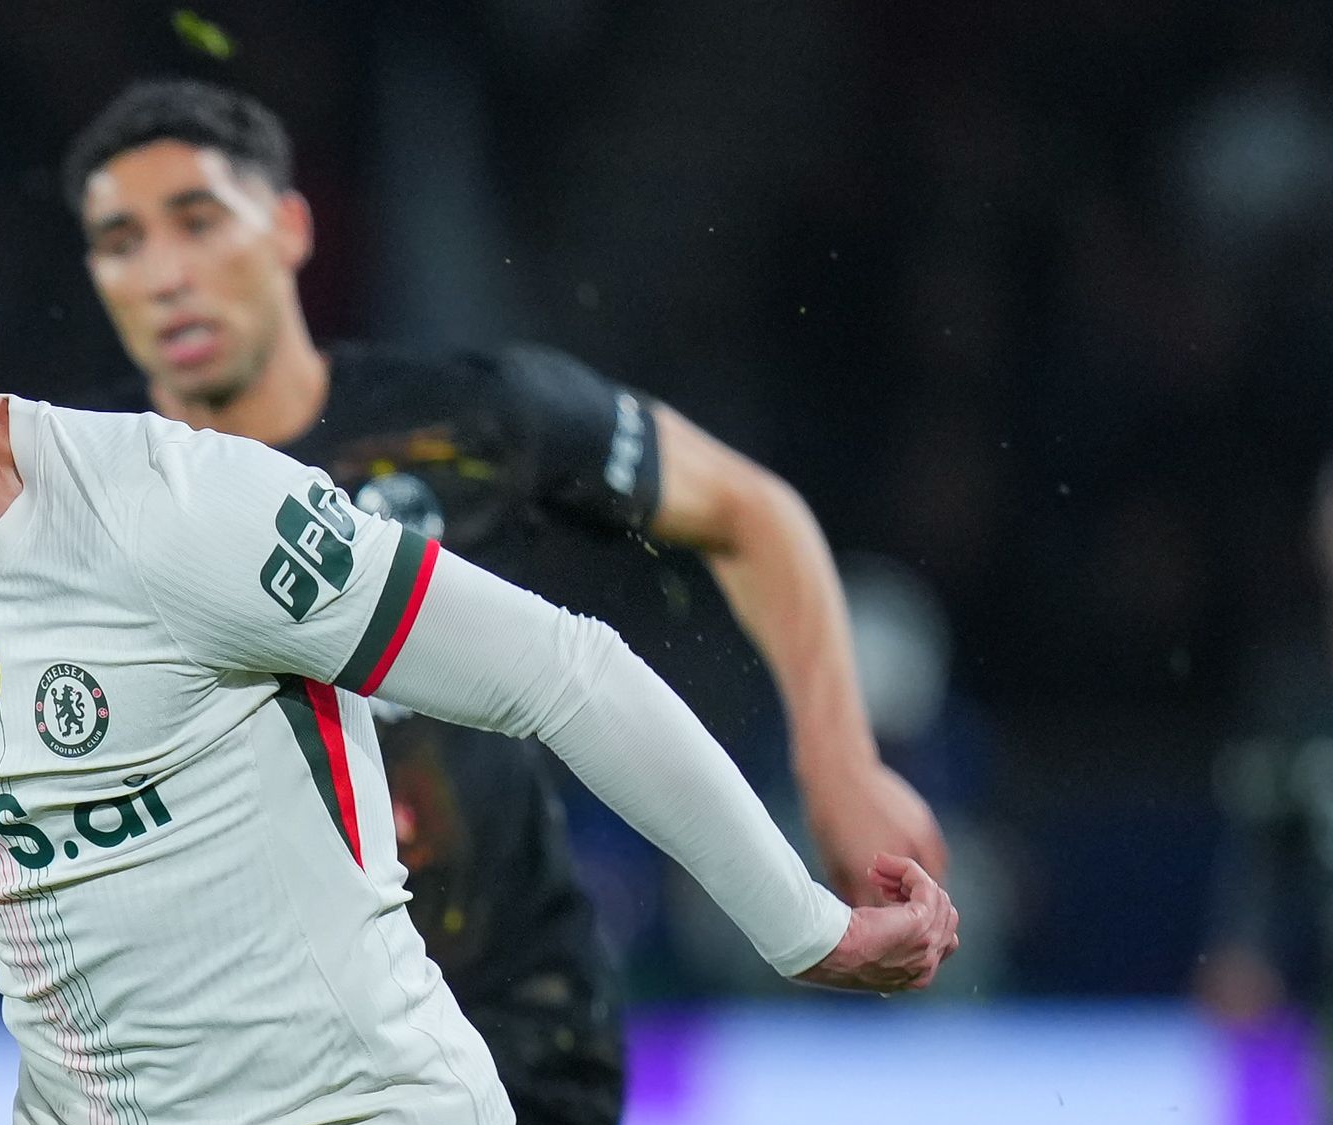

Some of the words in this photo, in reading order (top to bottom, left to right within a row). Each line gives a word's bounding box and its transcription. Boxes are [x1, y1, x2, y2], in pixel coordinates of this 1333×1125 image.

[40, 665, 86, 690] CHELSEA
[49, 741, 86, 755] FOOTBALL
[86, 730, 103, 748] CLUB
